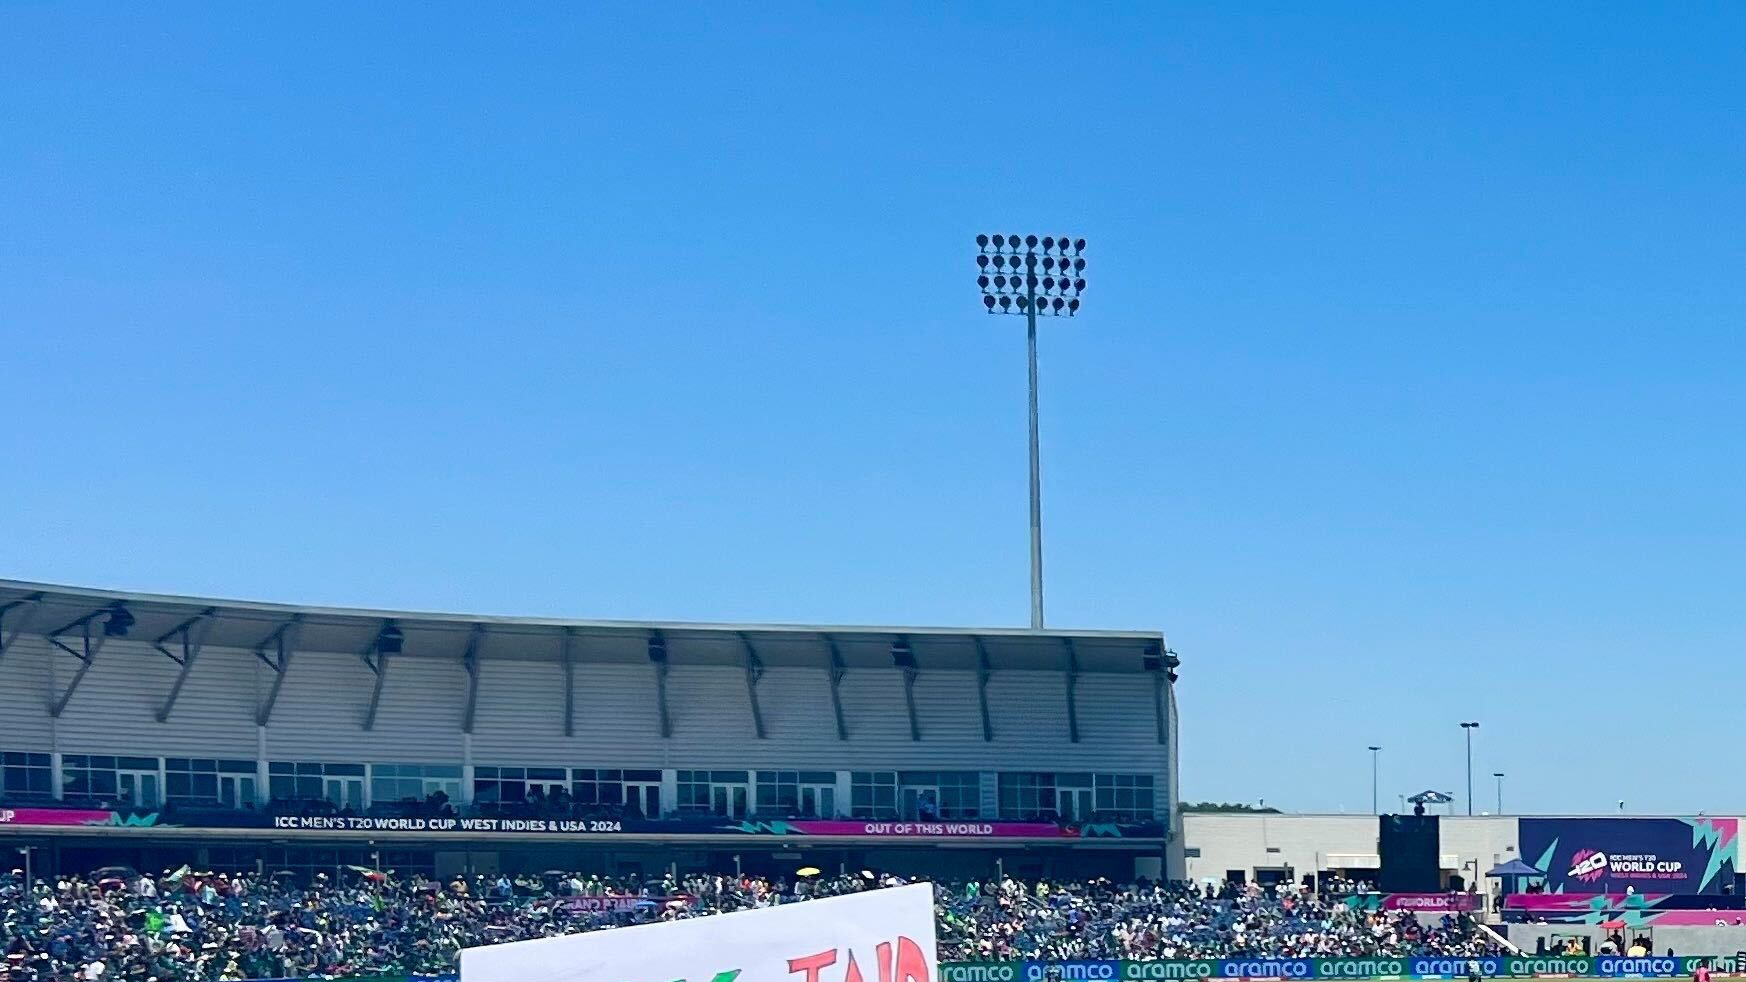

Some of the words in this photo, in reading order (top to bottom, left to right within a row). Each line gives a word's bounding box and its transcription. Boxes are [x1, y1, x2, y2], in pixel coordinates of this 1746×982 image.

[275, 817, 298, 828] ICC
[301, 817, 345, 829] MEN'S
[348, 818, 372, 829] T20
[375, 818, 426, 830] WORLD
[429, 819, 456, 830] CUP
[461, 819, 498, 831] WEST
[501, 820, 546, 831] INDIES
[549, 821, 558, 832] &
[561, 821, 586, 831] USA
[590, 821, 621, 832] 2024
[865, 823, 891, 834] OUT
[895, 823, 912, 834] OF
[914, 824, 943, 835] THIS
[945, 824, 992, 835] WORLD
[1610, 862, 1655, 872] WORLD
[1657, 862, 1682, 872] CUP
[941, 965, 1014, 982] ramco
[1027, 963, 1113, 981] amco
[1127, 962, 1211, 980] aramco
[1224, 961, 1307, 978] aramco
[1319, 960, 1401, 977] aramco
[1415, 960, 1496, 976] aramo
[1510, 960, 1589, 976] aramco
[1601, 959, 1676, 975] aramco
